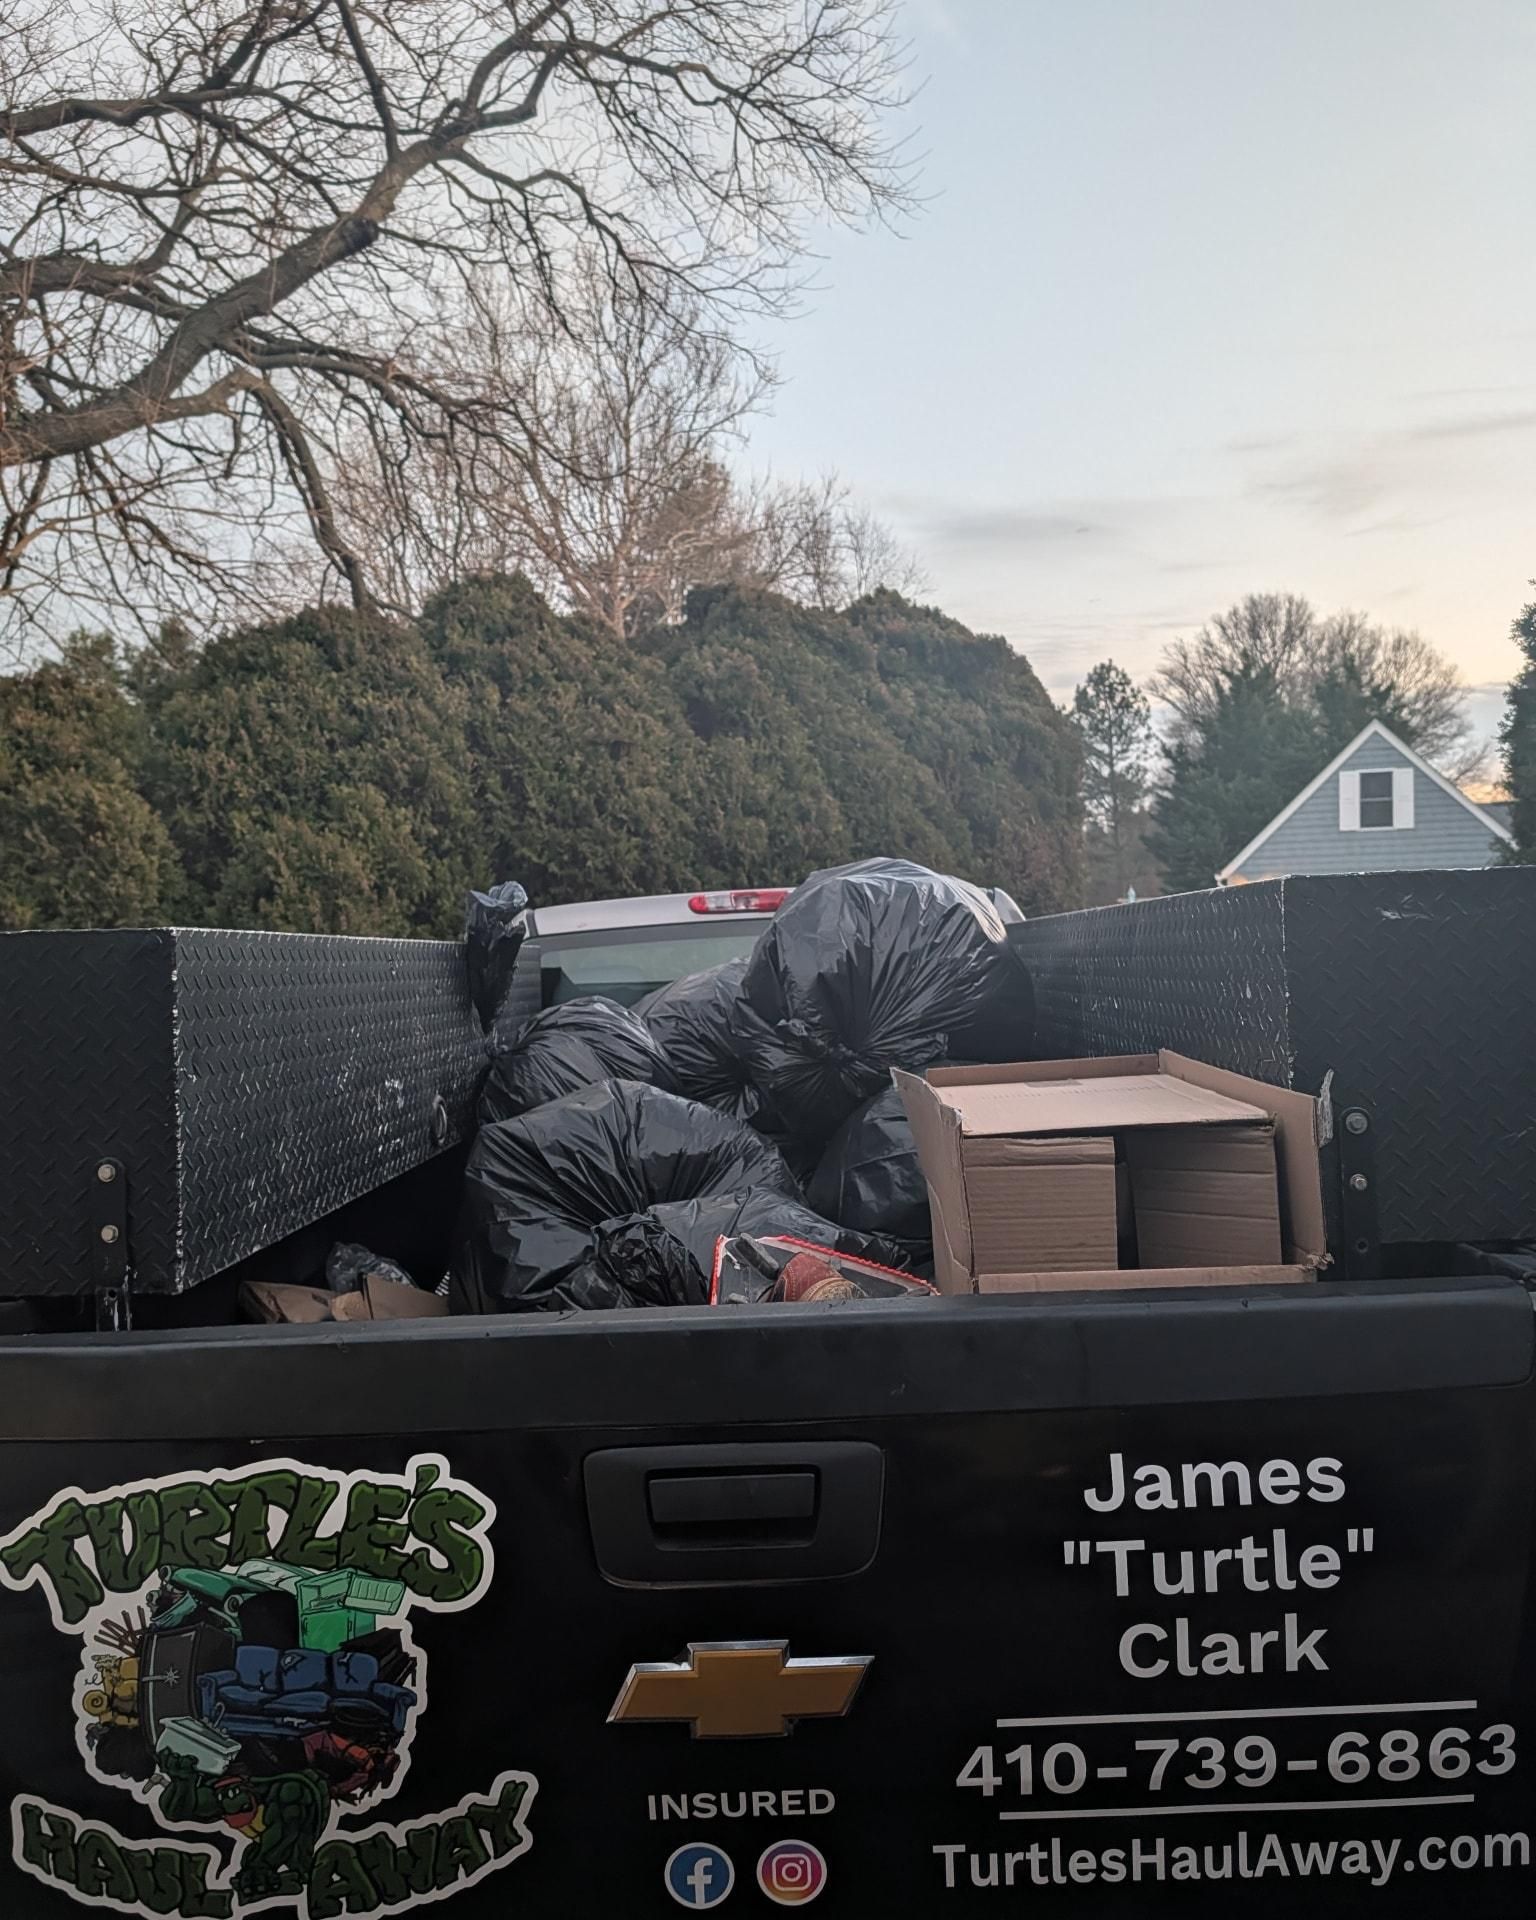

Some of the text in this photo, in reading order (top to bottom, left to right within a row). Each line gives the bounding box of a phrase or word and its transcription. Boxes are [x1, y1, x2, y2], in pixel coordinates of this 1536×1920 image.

[1083, 1452, 1347, 1513] James
[1, 1462, 487, 1624] TURTLE'S
[1063, 1527, 1375, 1597] "Turtle"
[1118, 1612, 1330, 1679] Clark
[955, 1723, 1517, 1797] 410-739-6863
[648, 1788, 836, 1821] INSURED
[20, 1780, 529, 1919] HAUL AWAY
[932, 1830, 1531, 1889] TurtlesHaulAway.com
